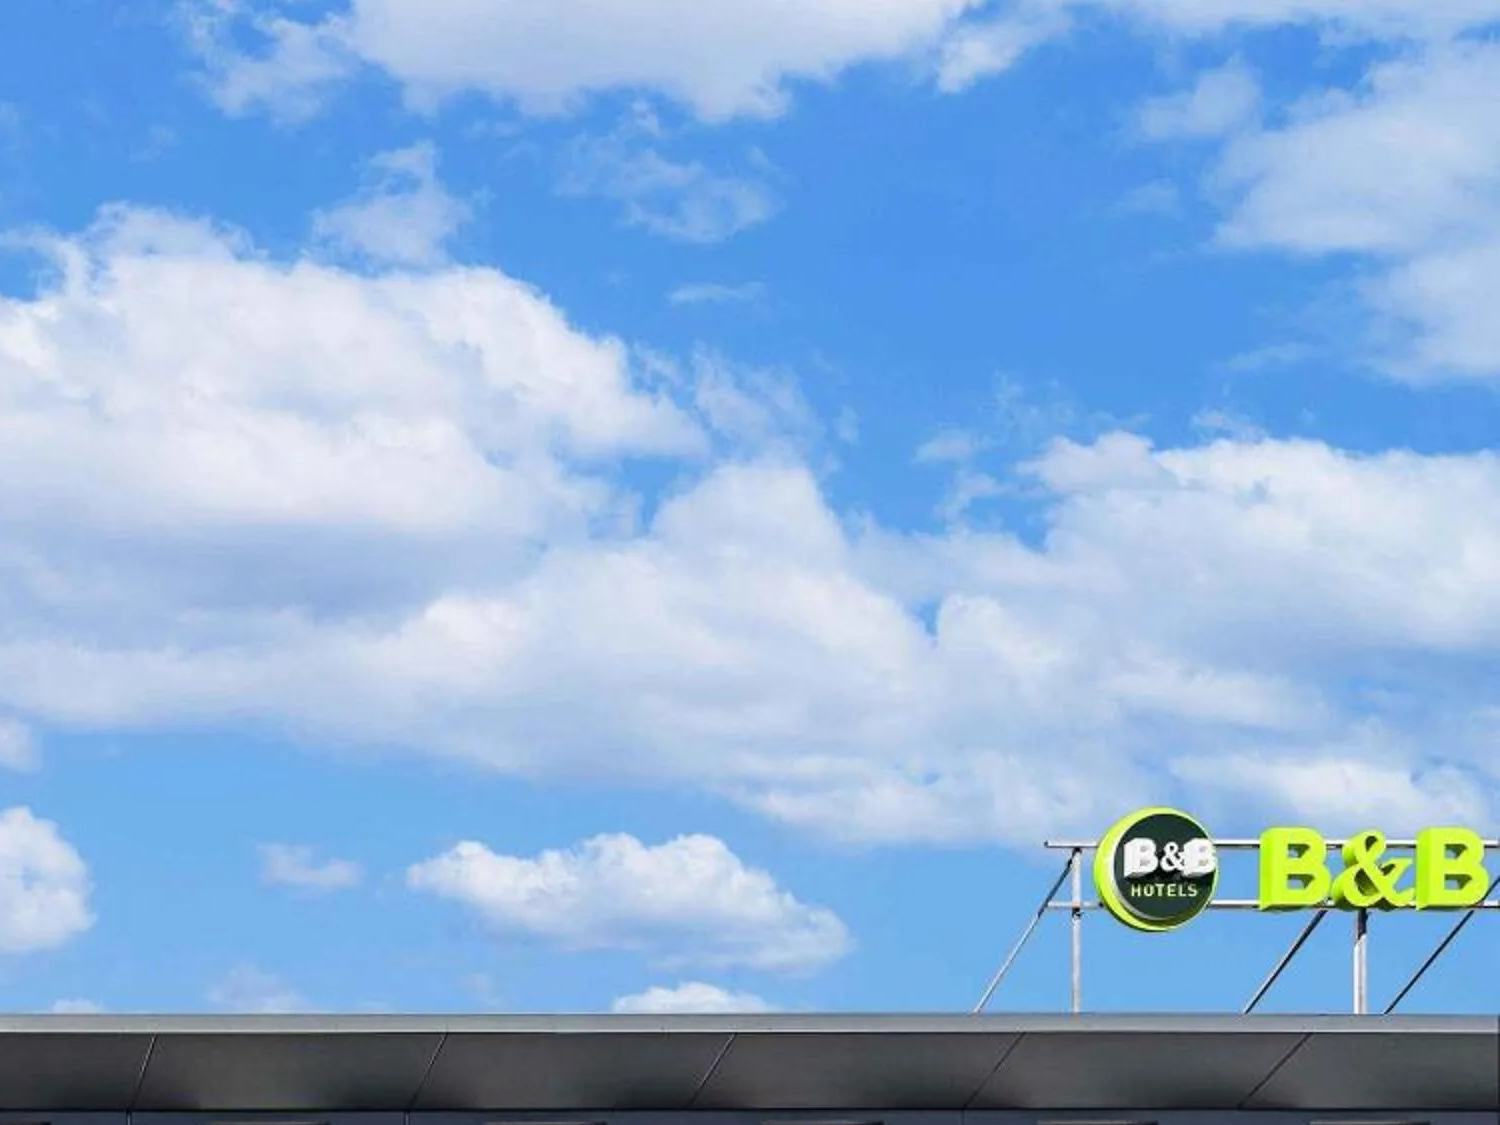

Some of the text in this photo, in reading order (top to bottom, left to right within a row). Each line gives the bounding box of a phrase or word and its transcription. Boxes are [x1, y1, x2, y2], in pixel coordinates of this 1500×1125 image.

[1123, 837, 1217, 878] B&B
[1259, 826, 1491, 911] B&B
[1130, 883, 1198, 897] HOTELS
